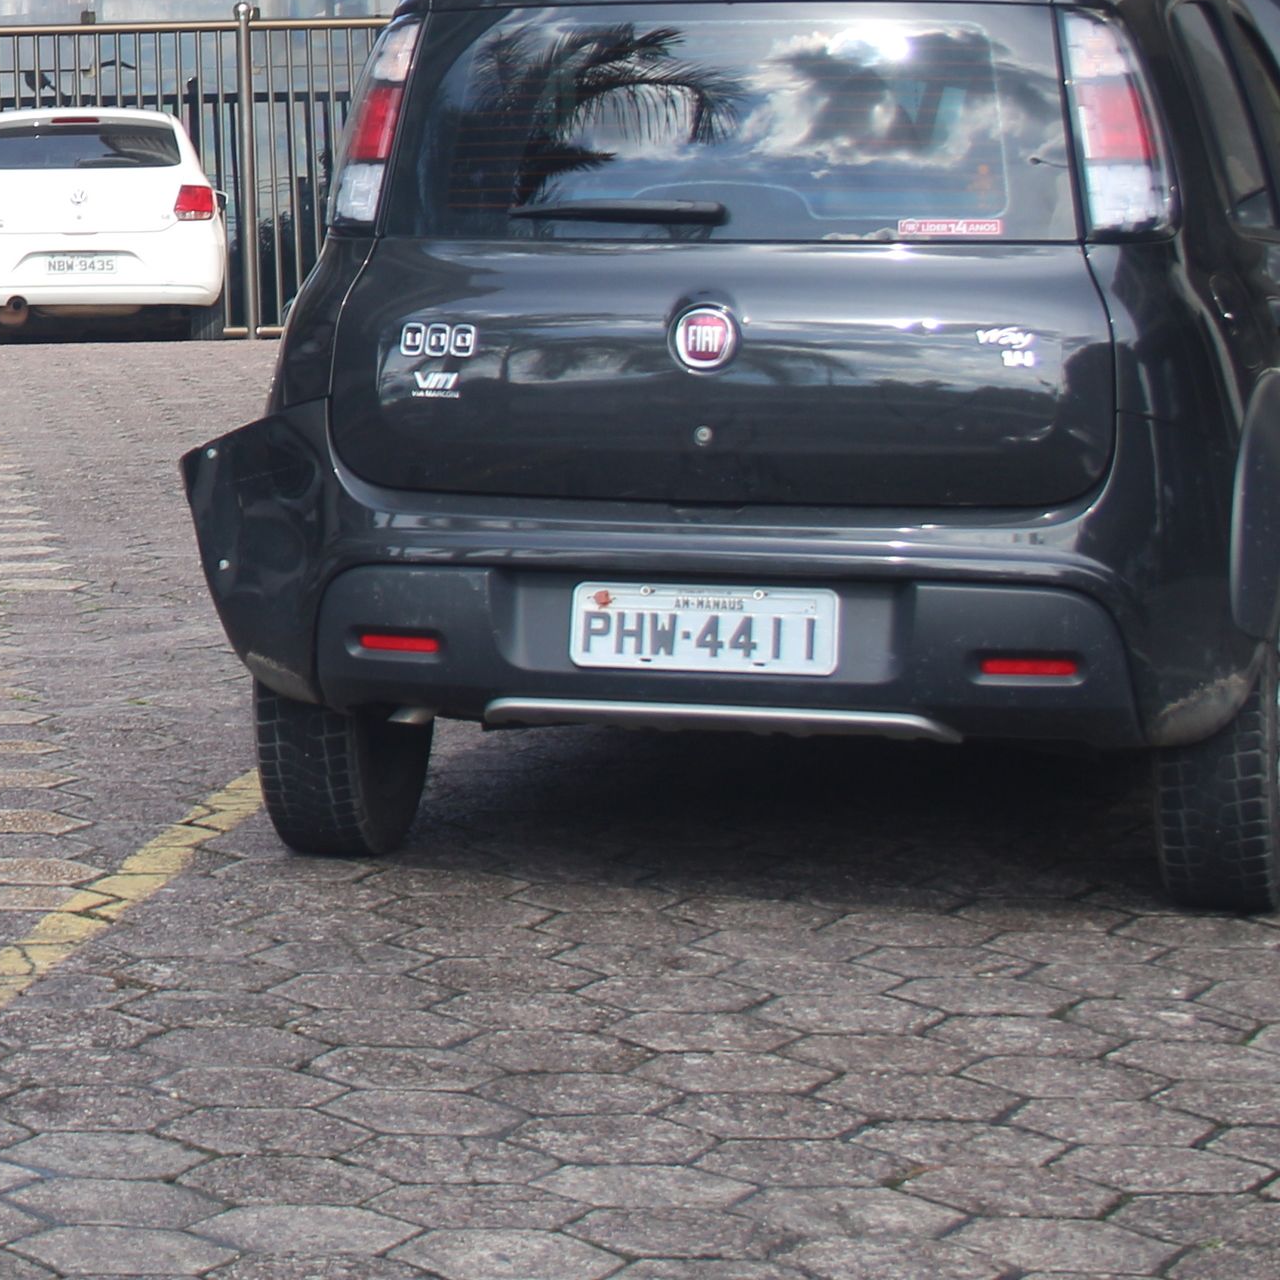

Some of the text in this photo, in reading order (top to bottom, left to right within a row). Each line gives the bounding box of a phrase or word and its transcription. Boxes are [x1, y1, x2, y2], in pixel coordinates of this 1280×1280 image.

[948, 220, 967, 234] 14
[968, 223, 997, 232] ANOS
[687, 324, 723, 353] FIAT
